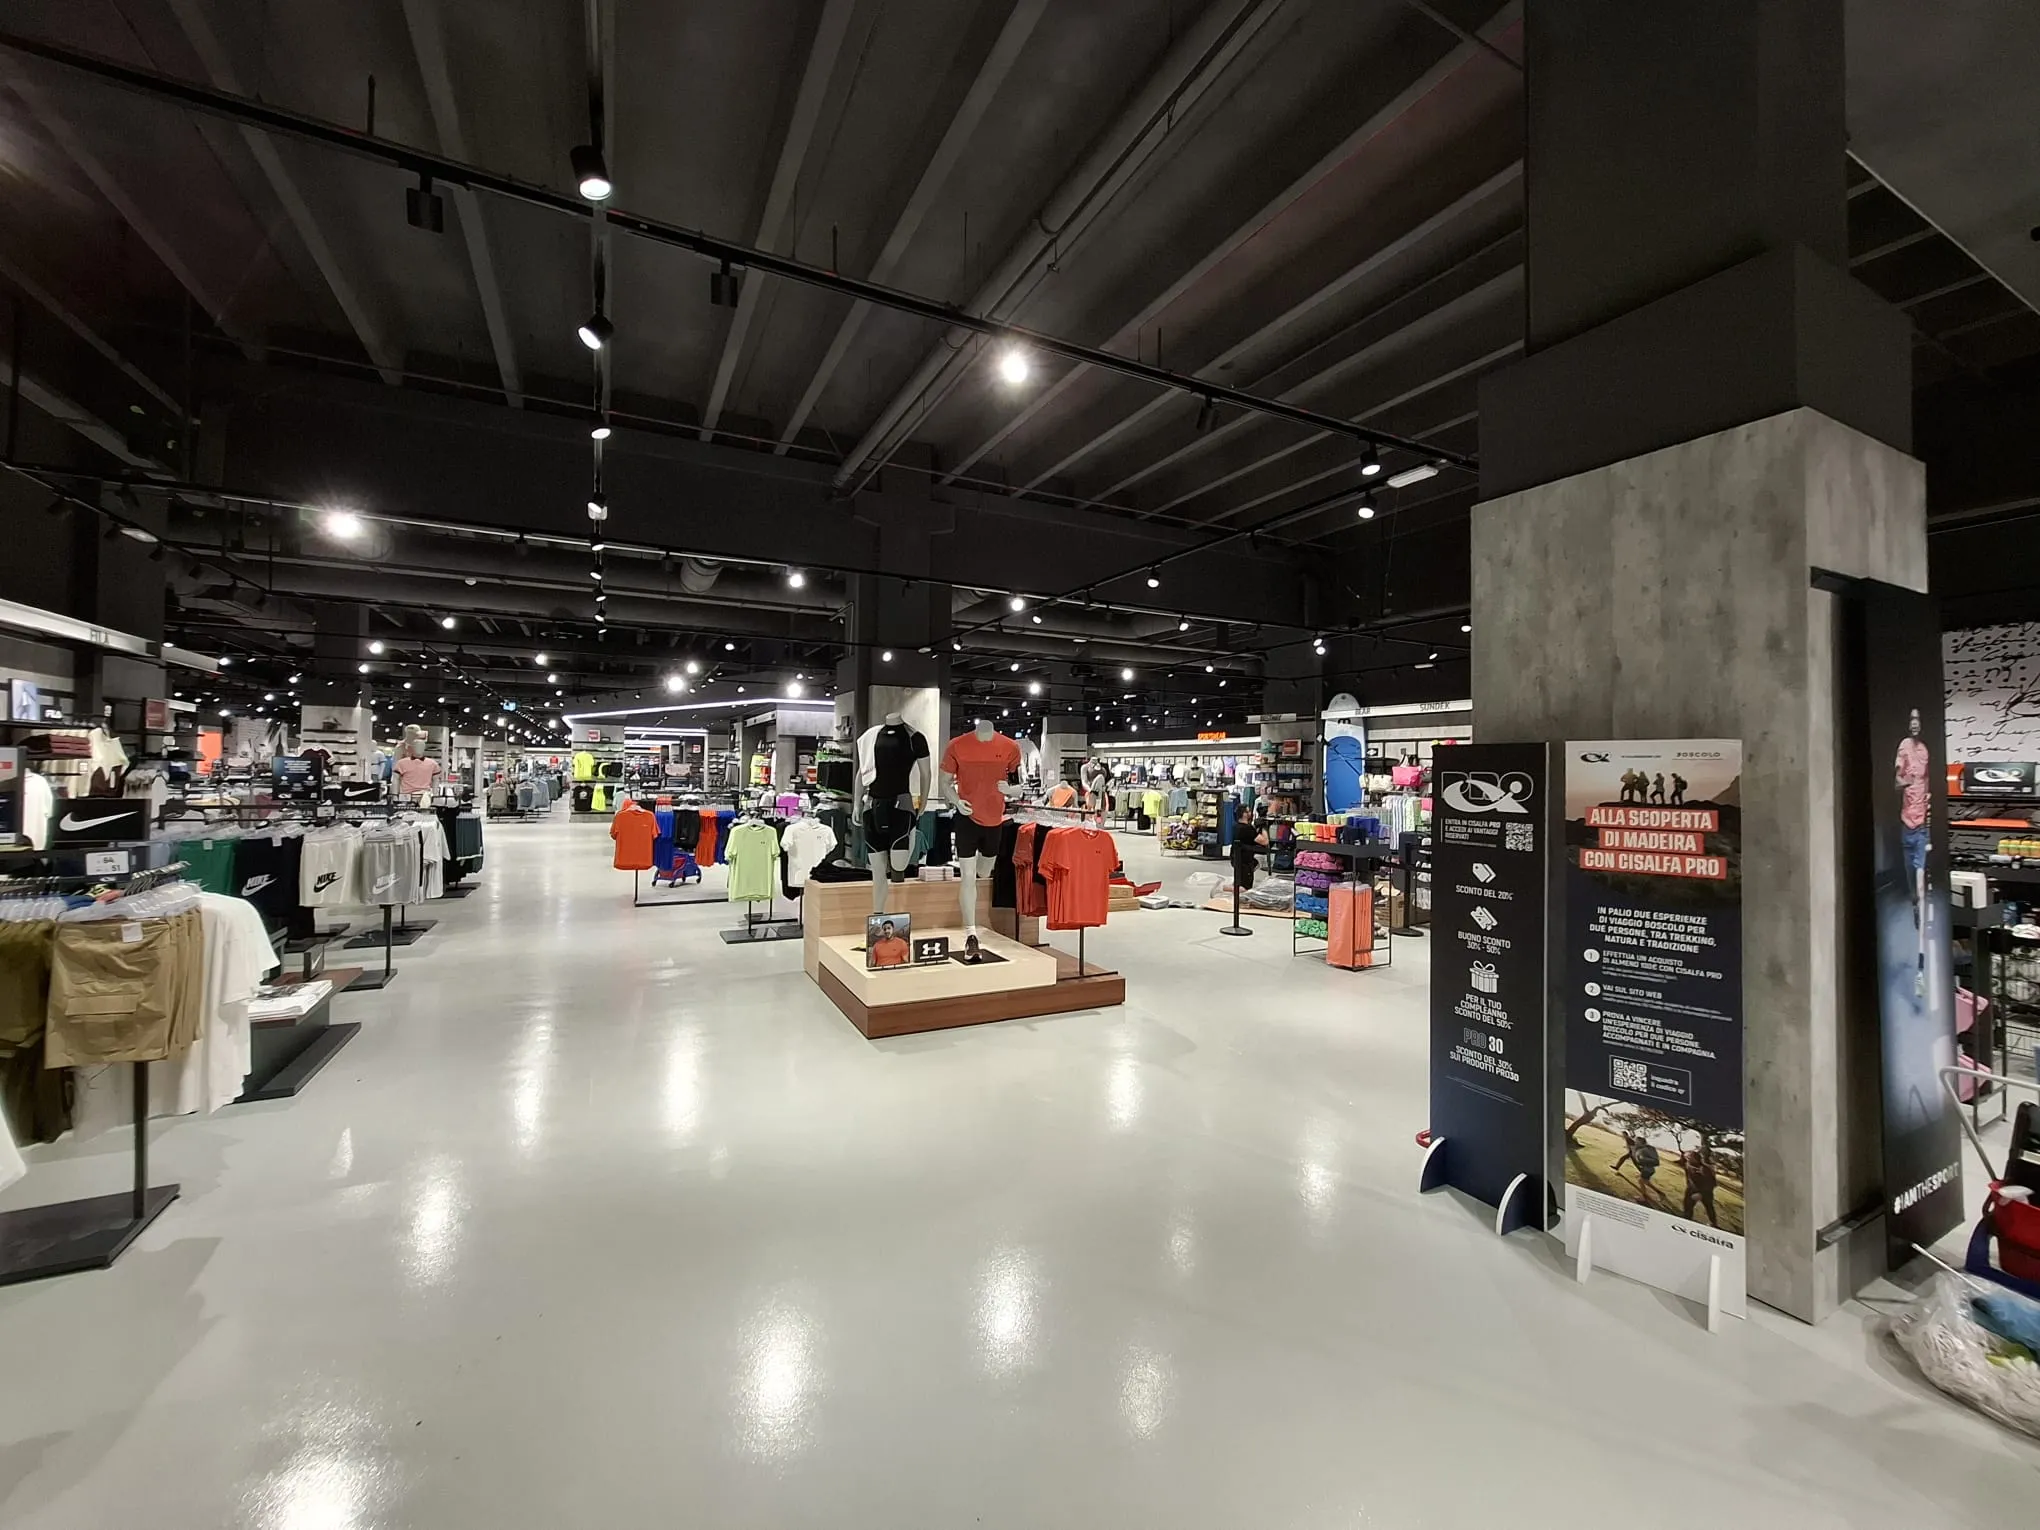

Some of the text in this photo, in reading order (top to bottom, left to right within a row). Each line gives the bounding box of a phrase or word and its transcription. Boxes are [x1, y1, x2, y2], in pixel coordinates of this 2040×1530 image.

[1590, 809, 1712, 829] ALLA SCOPERTA
[1605, 831, 1697, 851] DI MADEIRA
[1585, 851, 1720, 876] CON CISALFA PRO
[317, 872, 337, 885] NIKE
[1456, 885, 1482, 896] SCONTO
[1484, 888, 1496, 898] DEL
[1597, 906, 1708, 925] IN PALIO DUE ESPERIENZE
[1609, 916, 1643, 927] VIAGGIO
[1644, 920, 1685, 933] BOSCOLO
[1687, 925, 1705, 935] PER
[1458, 931, 1511, 949] BUONO SCONTO
[1589, 924, 1717, 947] DUE PERSONE, TRA TREKKING,
[1605, 935, 1699, 954] NATURA E TRADIZIONE
[1486, 945, 1501, 955] 50%
[1603, 950, 1683, 966] EFFETTUA UN ACQUISTO
[1610, 958, 1639, 968] ALMENO
[1659, 964, 1674, 973] CON
[1675, 966, 1704, 977] CISALFA
[1706, 971, 1723, 980] PRO
[1466, 993, 1502, 1010] PER IL TUO
[1615, 986, 1627, 994] SUL
[1629, 988, 1644, 996] SITO
[1646, 990, 1662, 999] WEB
[1454, 1007, 1481, 1021] SCONTO
[1482, 1014, 1496, 1025] DEL
[1461, 1000, 1508, 1020] COMPLEANNO
[1603, 1011, 1624, 1020] PROVA
[1631, 1015, 1662, 1026] VINCERE
[1602, 1025, 1634, 1036] BOSCOLO
[1635, 1030, 1649, 1039] PER
[1650, 1033, 1664, 1042] DUE
[1665, 1029, 1694, 1039] VIAGGIO
[1488, 1036, 1503, 1054] 30
[1450, 1051, 1519, 1082] SUI PRODOTTI PRO30
[1455, 1045, 1513, 1071] SCONTO DEL 30%
